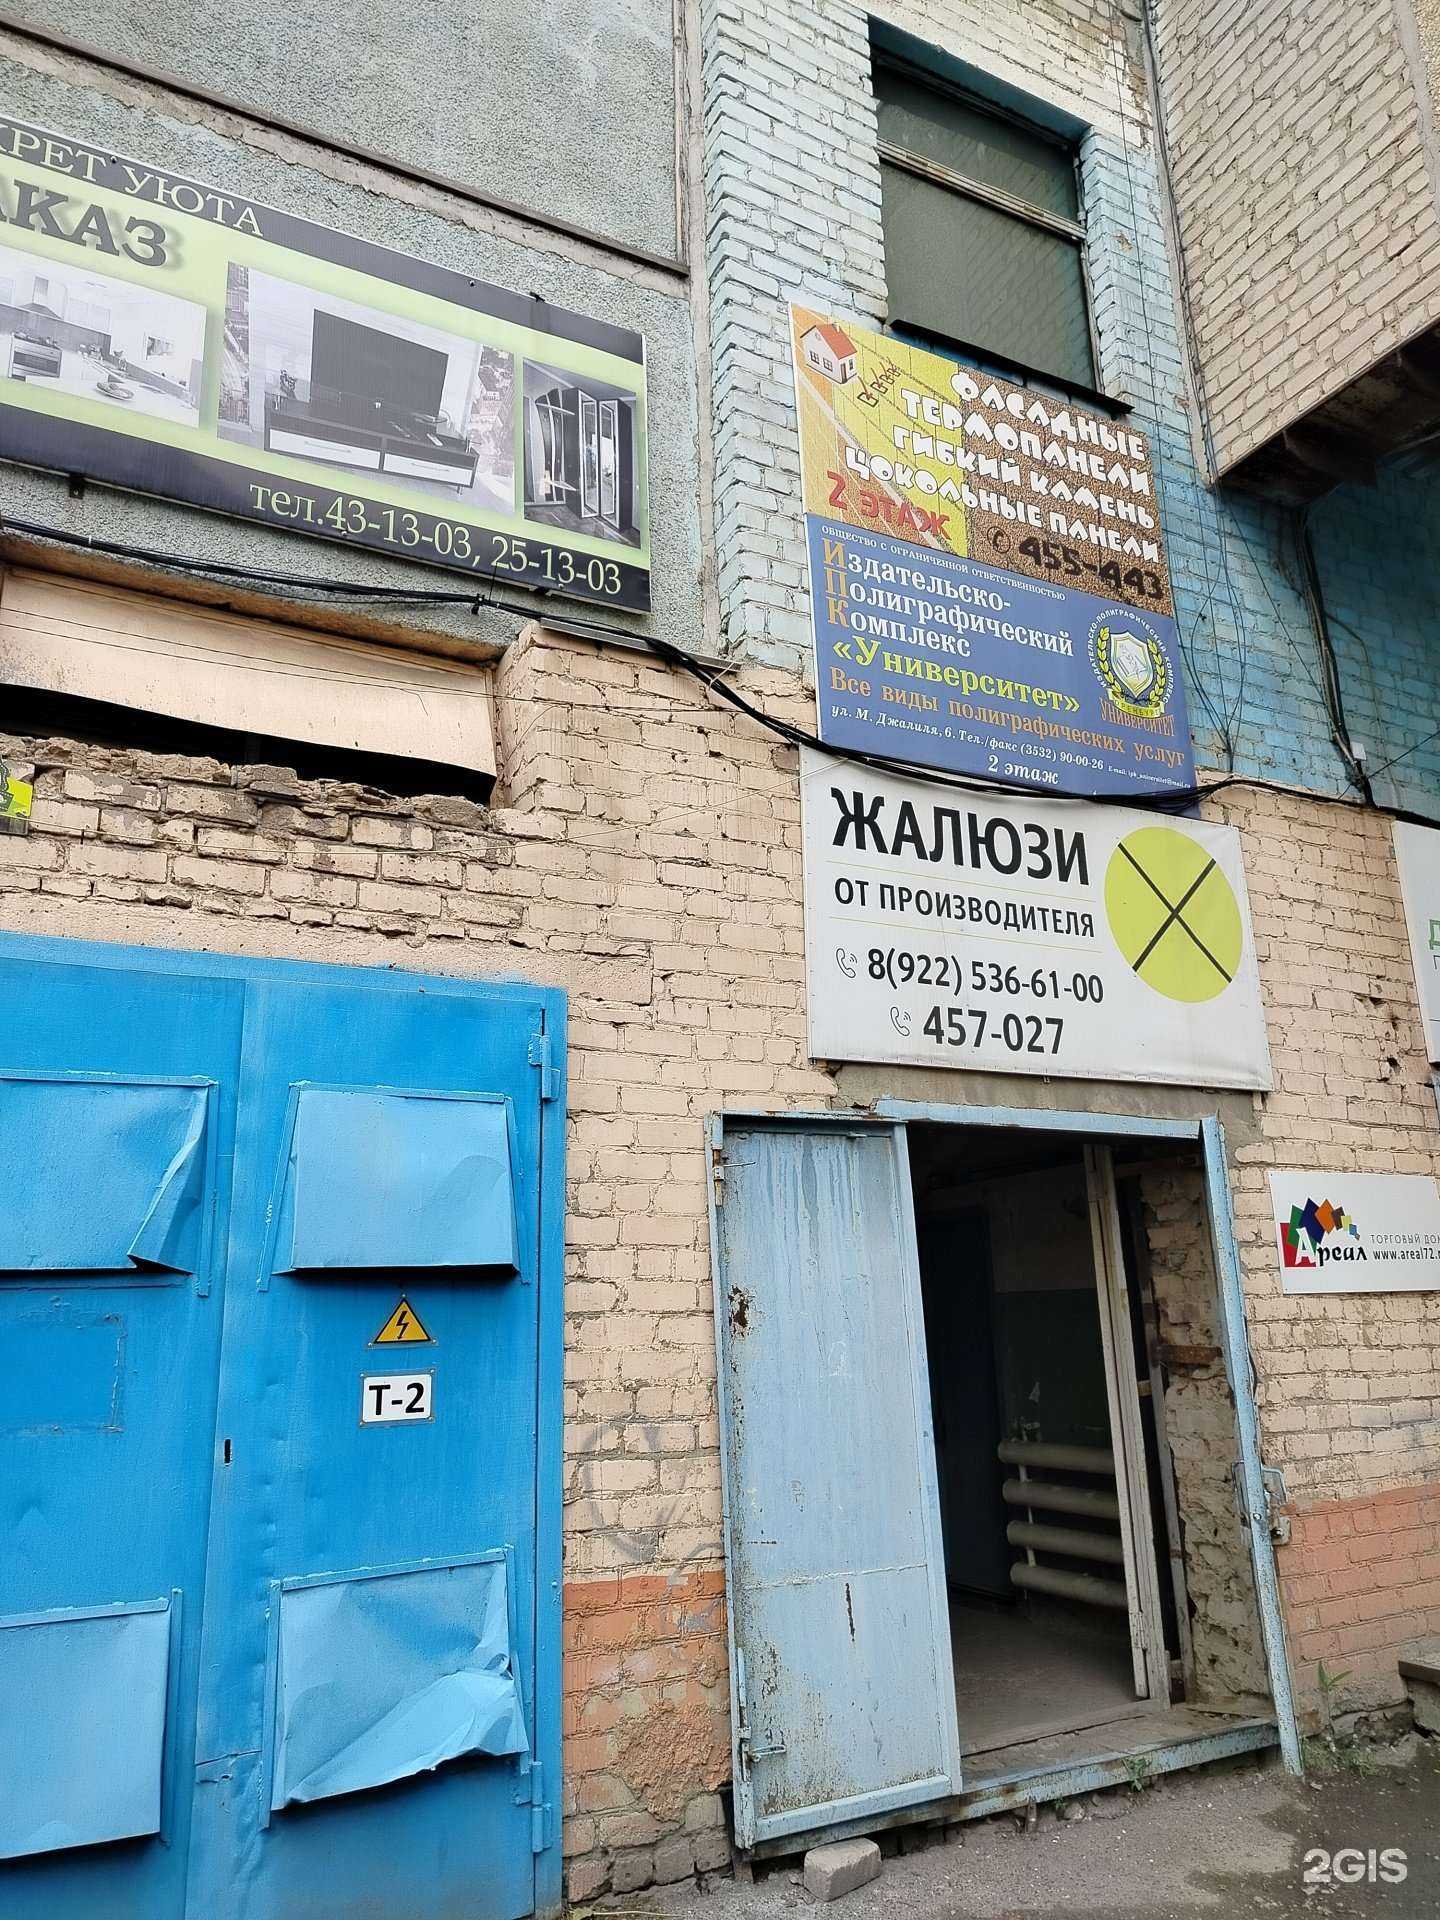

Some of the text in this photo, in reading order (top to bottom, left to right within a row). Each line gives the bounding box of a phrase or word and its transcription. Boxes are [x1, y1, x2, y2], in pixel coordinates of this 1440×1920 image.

[0, 178, 167, 267] КАЗ
[121, 164, 264, 237] УЮТА
[901, 388, 1151, 497] ТЕРМОПАНЕЛИ
[950, 371, 1147, 462] ФАСАДНЫЕ
[826, 470, 952, 541] 2 ЭТАЖ
[844, 446, 1160, 564] ЦОКОЛЬНЫЕ ПАНЕЛИ
[892, 424, 1155, 529] ГИБКИЙ КАМЕНЬ
[250, 483, 622, 594] тел.43-13-03, 25-13-03
[821, 525, 1066, 601] ОБЩЕСТВО С ОГРАНИЧЕННОЙ ОТВЕТСТВЕННОСТЬЮ
[823, 537, 1012, 612] Издательско-
[1018, 536, 1163, 601] 455-443
[824, 567, 1074, 657] Полиграфический
[826, 596, 972, 658] Комплекс
[832, 634, 1081, 714] «Университет»
[830, 667, 1185, 768] Все виды полиграфических услуг
[831, 705, 853, 719] ул.
[856, 709, 873, 722] М.
[875, 711, 945, 738] Джалиля,
[944, 725, 956, 739] 6.
[958, 729, 1018, 752] Тел./факс
[1020, 740, 1057, 763] (3532)
[1059, 750, 1104, 771] 90-00-26
[987, 754, 1059, 785] 2 этаж
[830, 787, 1090, 886] ЖАЛЮЗИ
[834, 877, 1095, 938] ОТ ПРОИЗВОДИТЕЛЯ
[867, 947, 1104, 1003] 8(922) 536-61-00
[923, 1005, 1064, 1056] 457-027
[1295, 1226, 1367, 1267] Ареал
[1369, 1233, 1421, 1244] ТОРГОВЫЙ
[368, 1382, 425, 1416] Т-2
